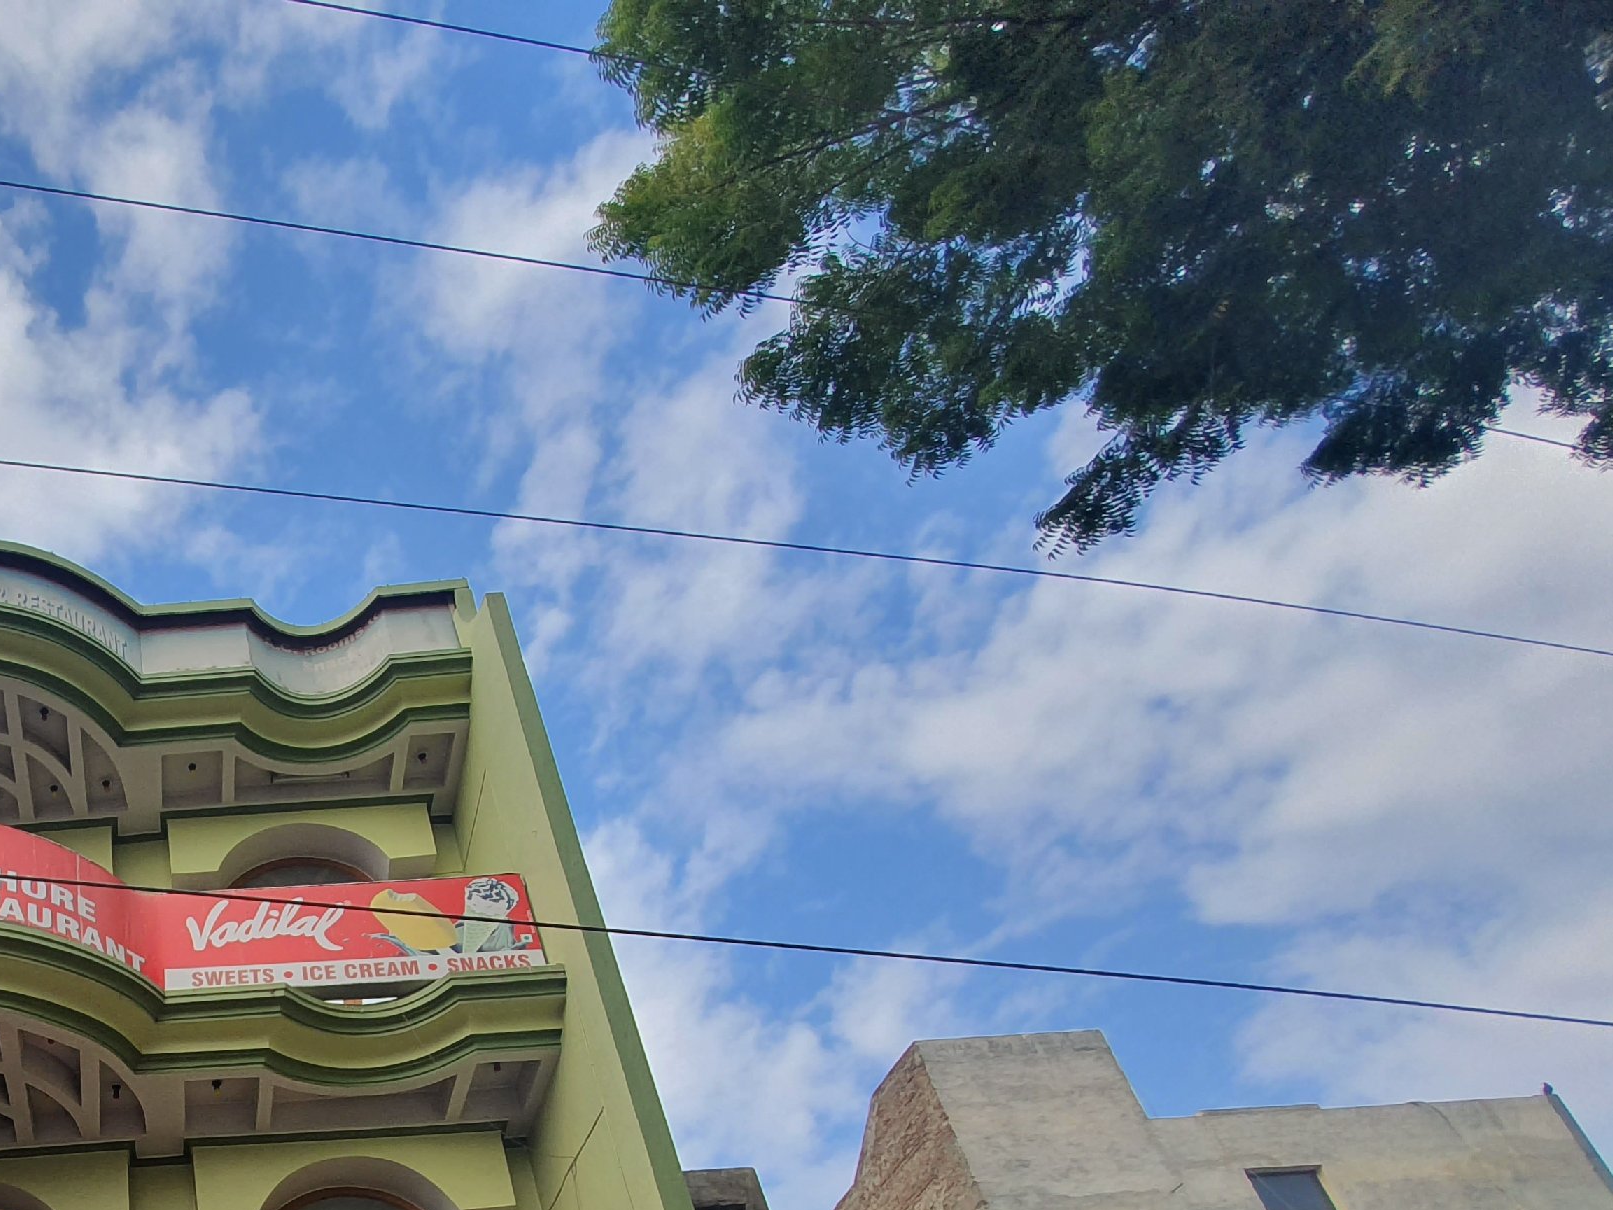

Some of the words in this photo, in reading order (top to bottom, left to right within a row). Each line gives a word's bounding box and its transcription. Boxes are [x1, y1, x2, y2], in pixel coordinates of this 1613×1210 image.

[186, 897, 345, 952] Vadilal
[191, 968, 275, 987] SWEETS
[302, 964, 337, 982] ICE
[344, 960, 420, 979] CREAM
[447, 954, 530, 972] SNACKS
